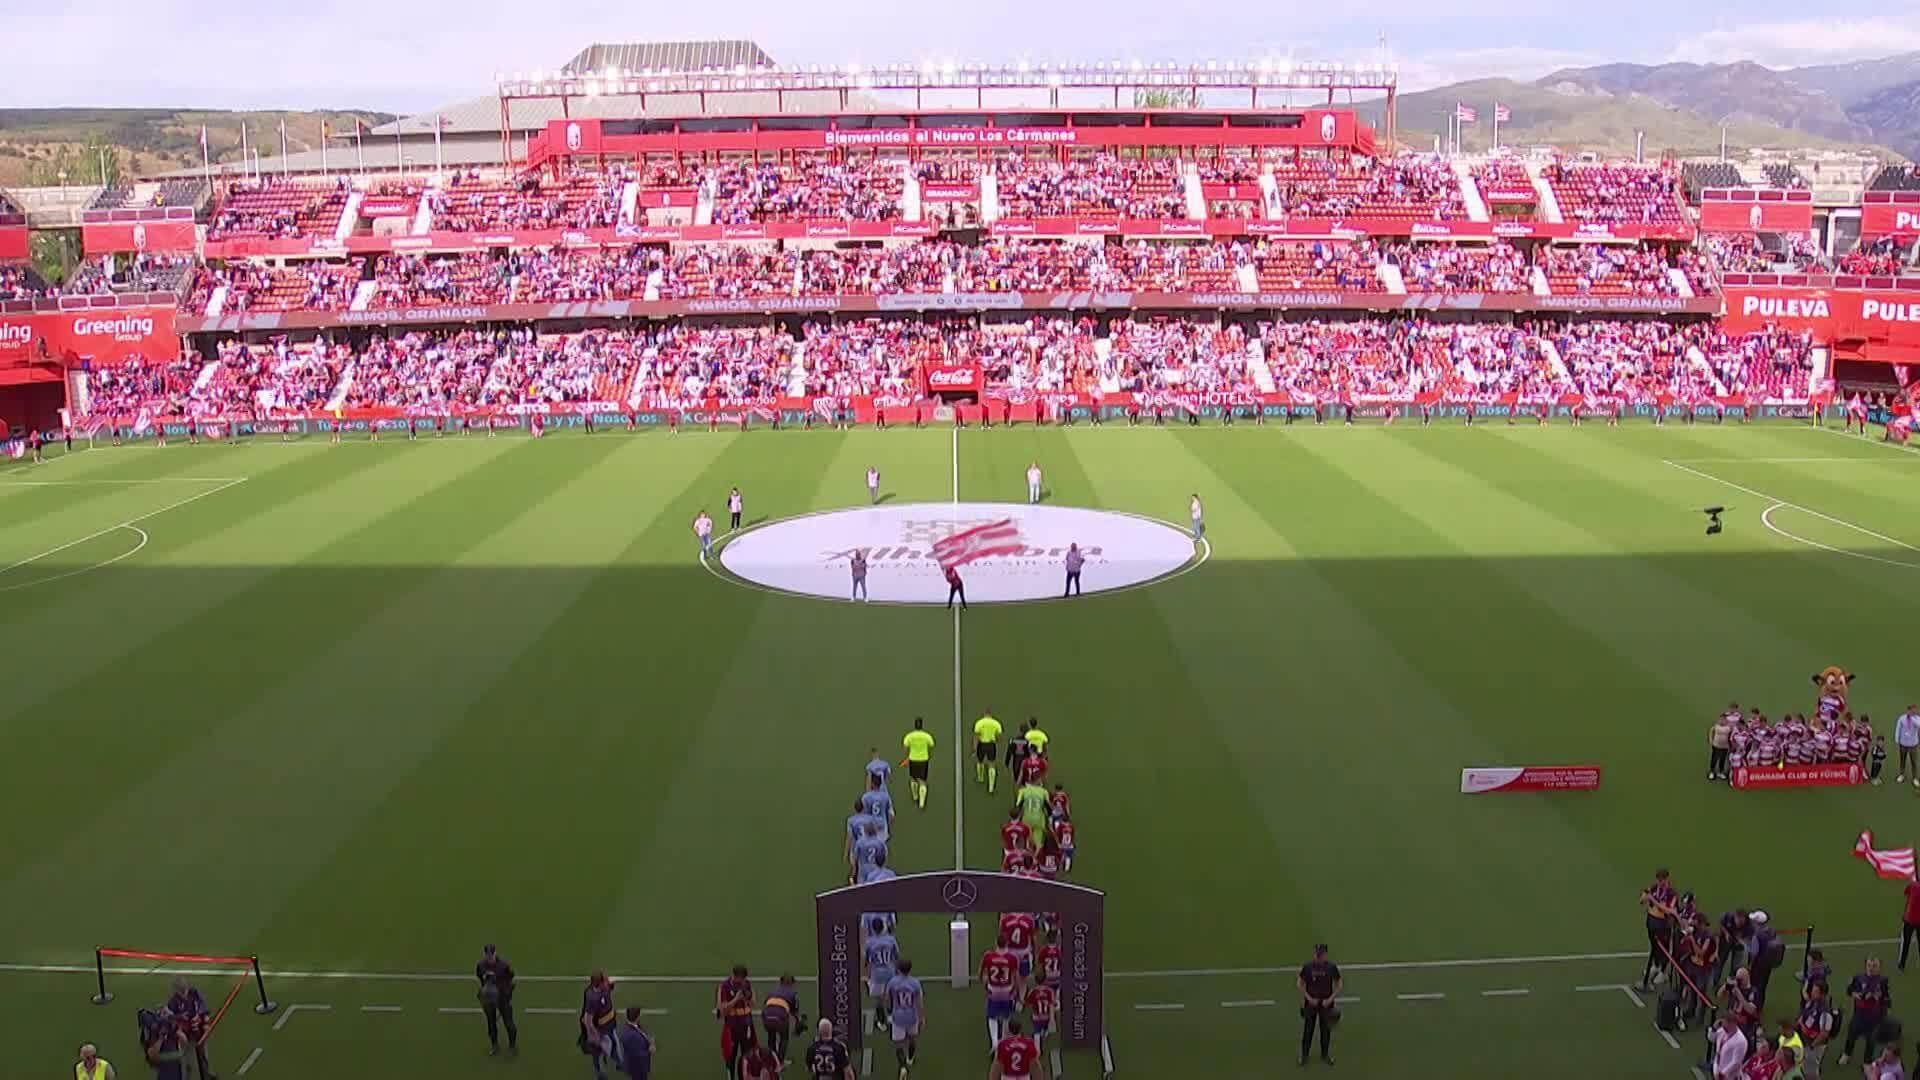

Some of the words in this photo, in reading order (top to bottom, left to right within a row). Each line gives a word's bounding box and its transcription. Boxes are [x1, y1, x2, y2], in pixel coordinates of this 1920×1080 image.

[825, 131, 909, 143] Bienvenidos
[933, 131, 975, 142] Nuevo
[980, 130, 1002, 141] Los
[1007, 129, 1075, 141] Cármenes
[758, 298, 840, 309] GRANADA!
[1260, 295, 1341, 305] GRANADA!
[1607, 299, 1686, 309] GRANADA!
[1743, 296, 1829, 317] PULEVA
[405, 308, 486, 319] GRANADA!
[74, 318, 153, 335] Greening
[593, 413, 658, 424] Nosoros
[1749, 772, 1786, 781] GRANADA
[1787, 771, 1807, 779] CLUB
[1808, 771, 1817, 779] DE
[1011, 928, 1021, 944] 4
[1073, 922, 1088, 977] Granada
[830, 923, 848, 1041] Mercedes-Benz
[815, 1054, 836, 1072] 25
